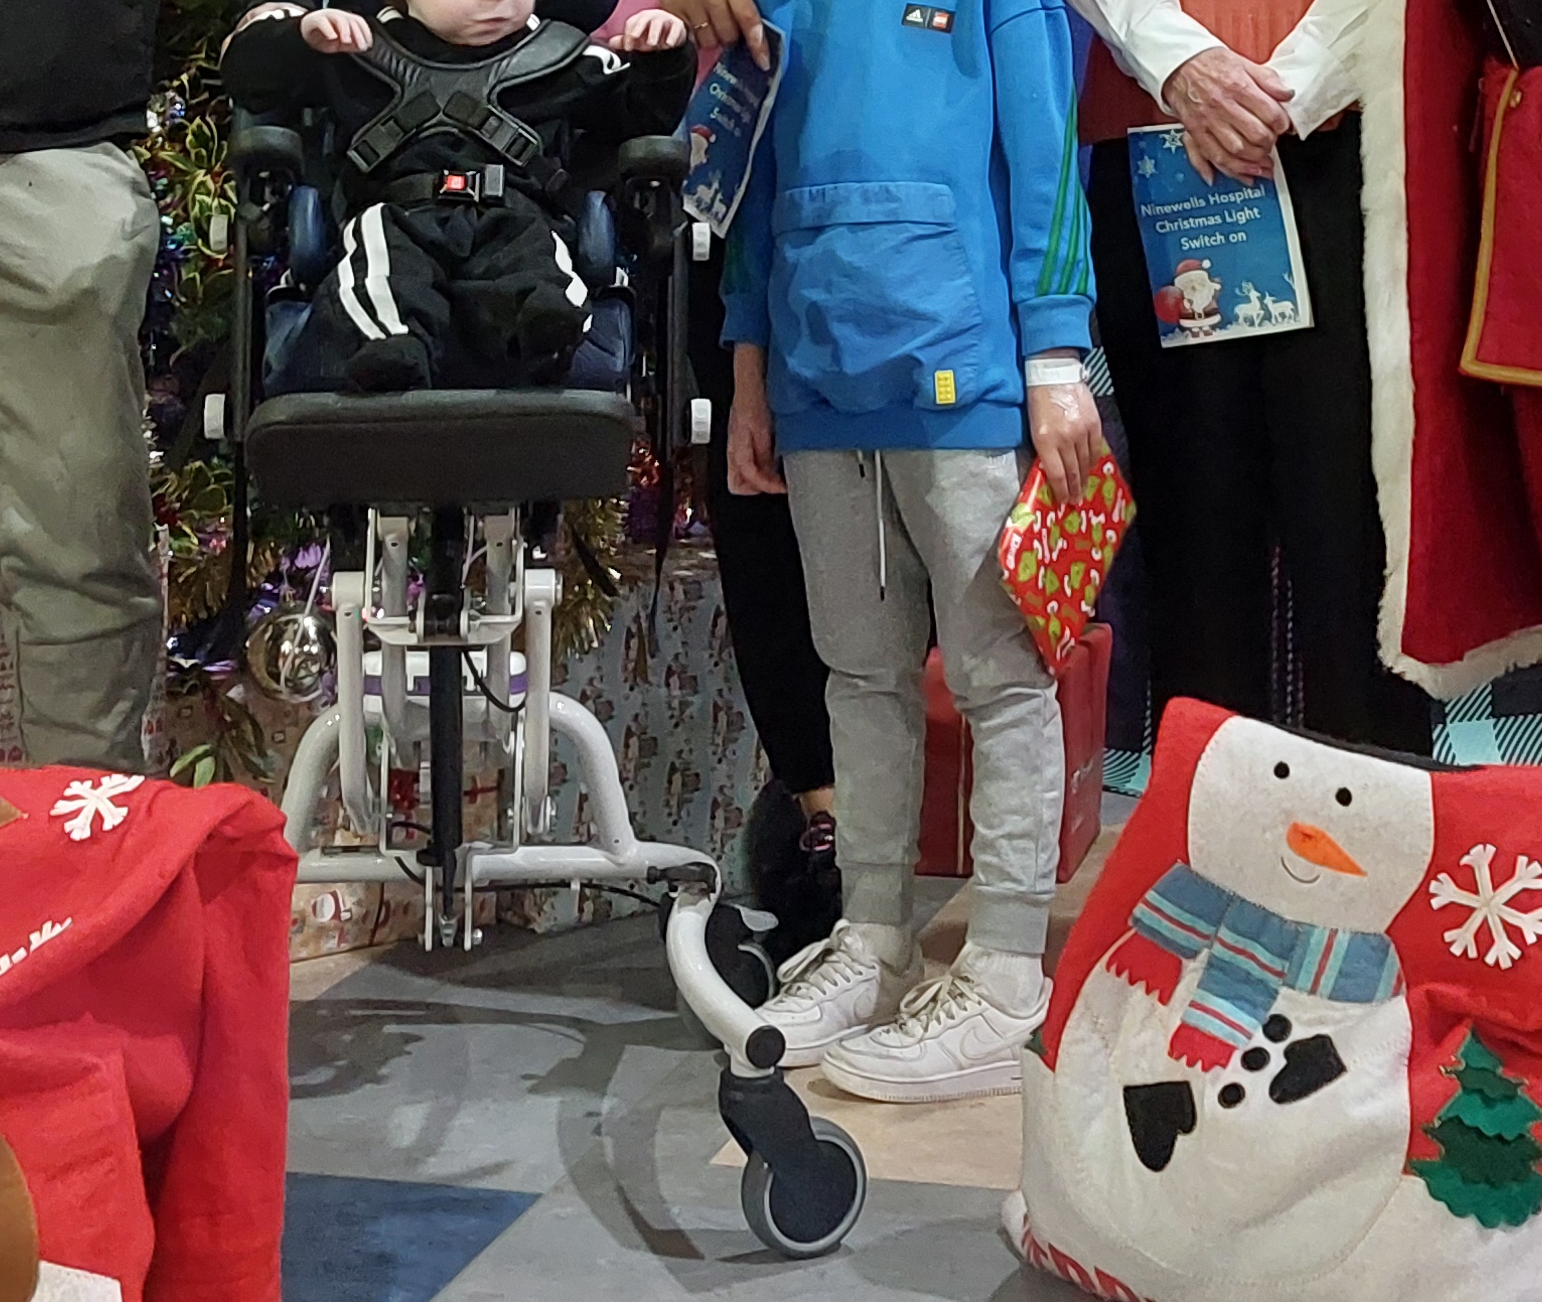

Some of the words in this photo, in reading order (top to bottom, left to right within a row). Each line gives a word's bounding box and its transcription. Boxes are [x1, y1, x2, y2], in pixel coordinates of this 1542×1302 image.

[1141, 197, 1206, 217] Ninewells
[1209, 184, 1265, 206] Hospital
[1156, 214, 1222, 233] Christmas
[1226, 206, 1261, 225] Light
[1181, 232, 1226, 251] Switch
[1229, 232, 1246, 243] on
